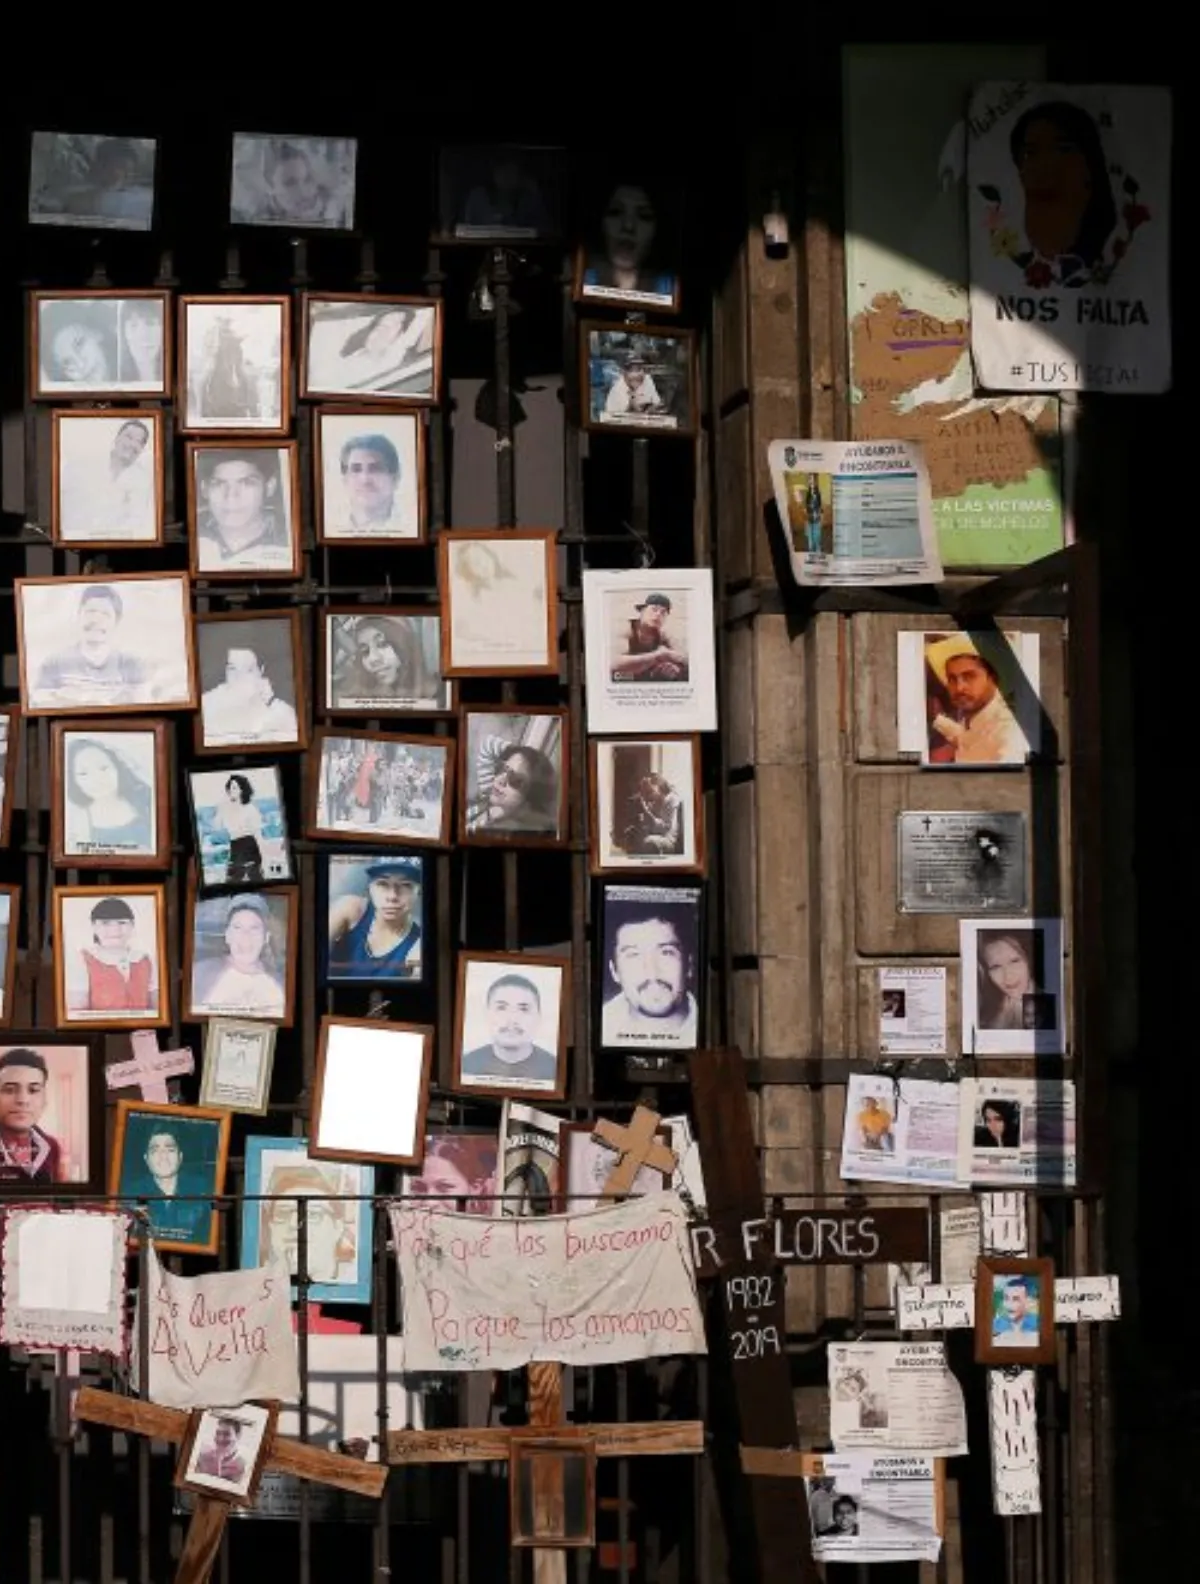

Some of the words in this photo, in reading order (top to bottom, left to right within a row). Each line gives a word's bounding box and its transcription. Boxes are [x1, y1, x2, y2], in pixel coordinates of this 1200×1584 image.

[996, 296, 1060, 322] NOS
[1077, 297, 1150, 326] FALTA
[942, 500, 951, 512] A
[955, 500, 983, 512] LAS
[451, 1224, 495, 1277] qué
[515, 1219, 546, 1258] los
[740, 1215, 881, 1261] FLORES
[726, 1275, 776, 1312] 1982
[533, 1302, 575, 1342] los
[585, 1306, 693, 1338] amamos
[730, 1326, 782, 1360] 2019
